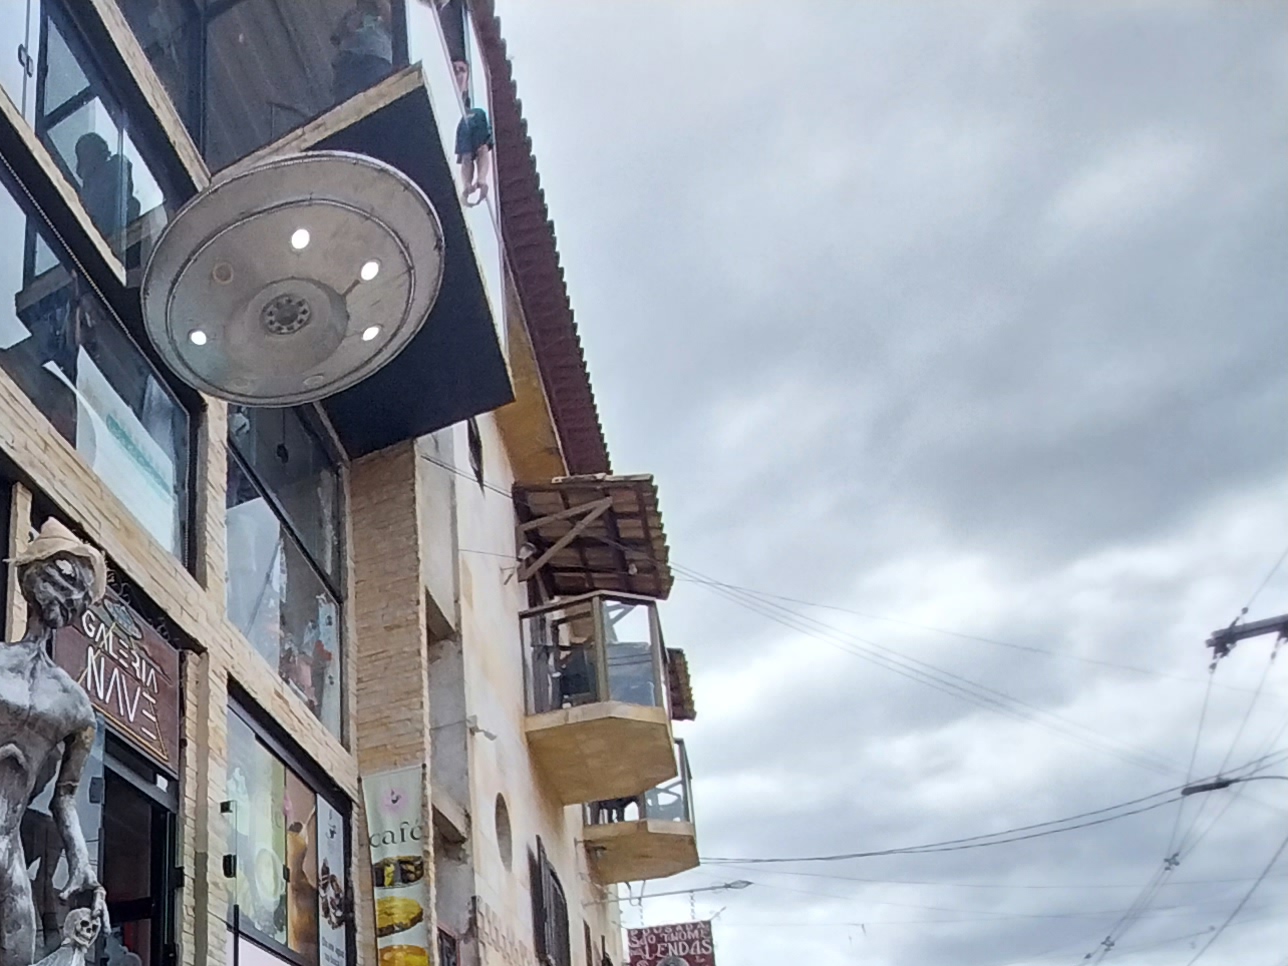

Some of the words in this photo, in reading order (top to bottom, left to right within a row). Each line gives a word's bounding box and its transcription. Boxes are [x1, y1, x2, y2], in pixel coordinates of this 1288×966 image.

[82, 610, 158, 693] GALERIA
[87, 646, 157, 740] NAVE
[369, 820, 423, 848] café
[642, 938, 712, 961] LENDAS
